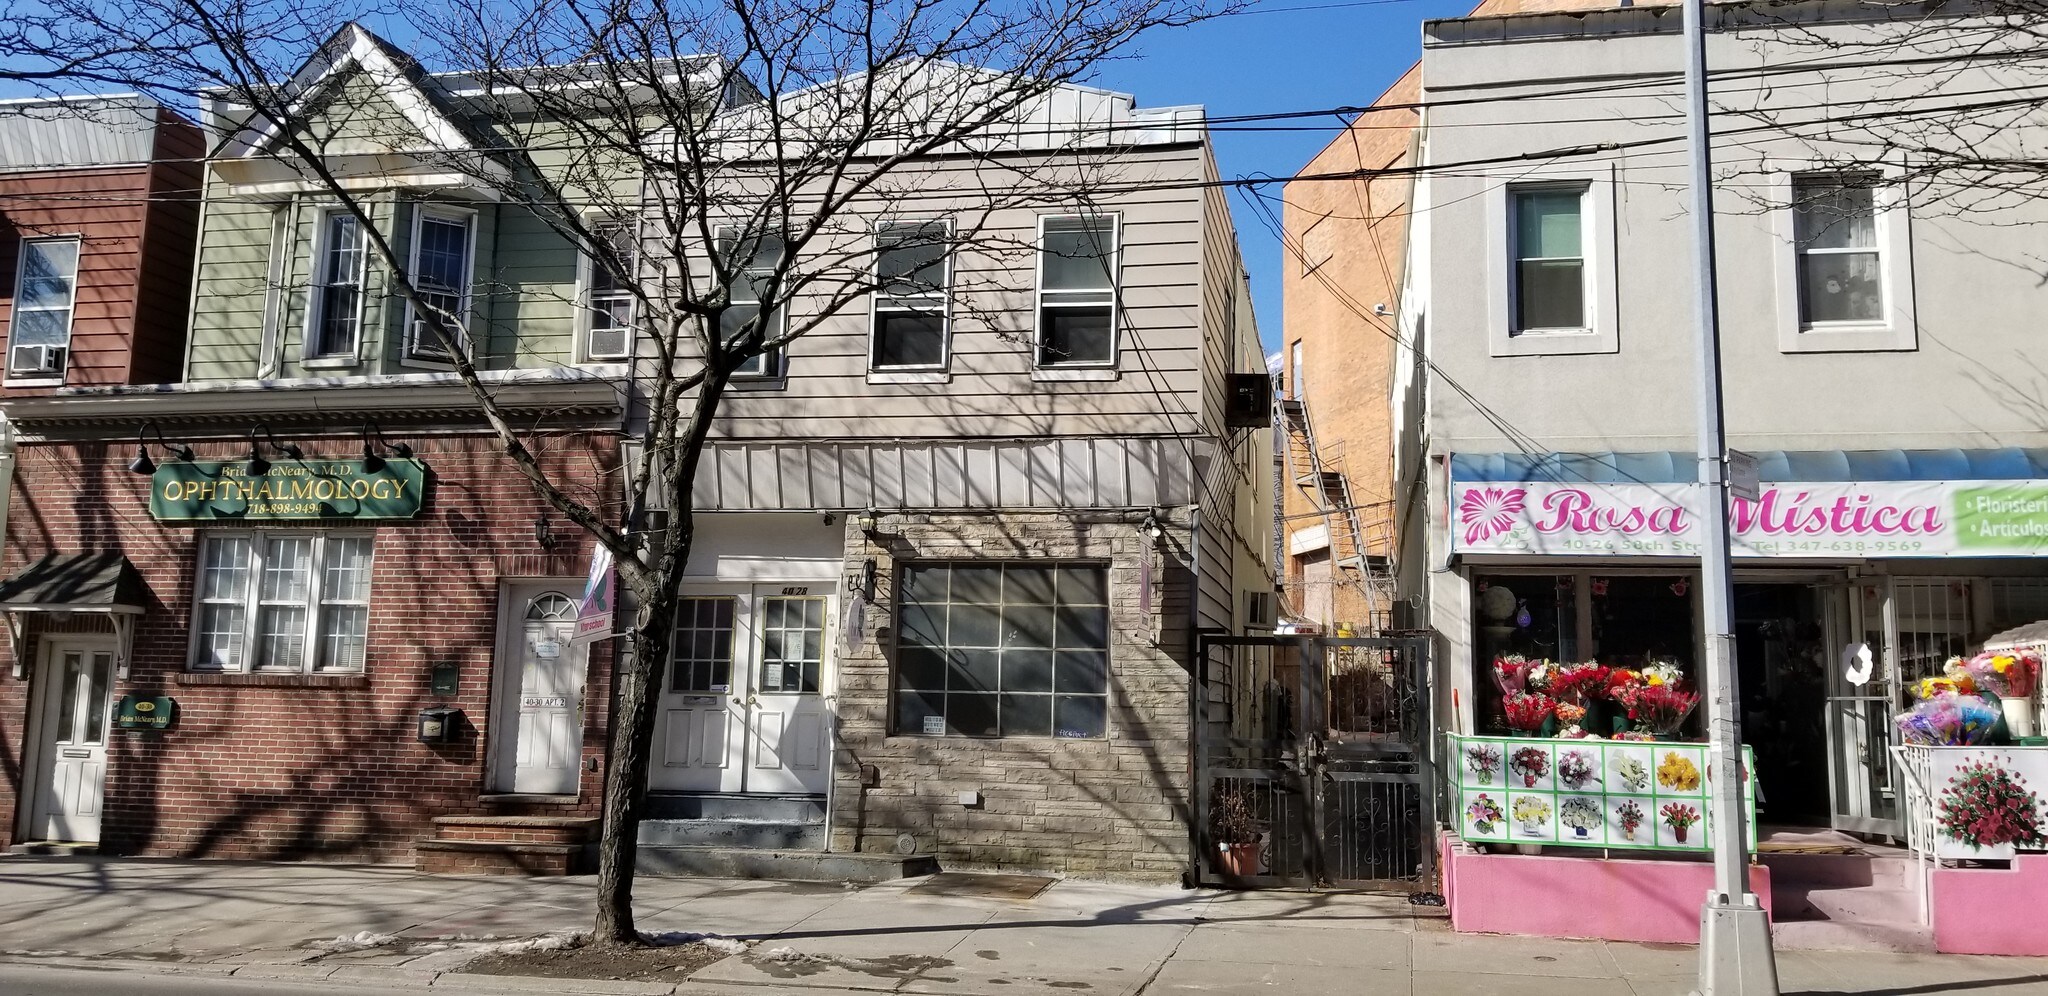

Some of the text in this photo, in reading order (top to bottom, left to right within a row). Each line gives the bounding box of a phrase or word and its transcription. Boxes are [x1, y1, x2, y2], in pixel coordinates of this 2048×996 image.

[221, 465, 246, 477] Bria
[265, 465, 315, 481] cNeary,
[339, 465, 353, 477] D.
[163, 478, 409, 501] OPHTHALMOLOGY
[247, 502, 323, 514] 718-898-9494
[1535, 488, 1944, 534] Rosa Mística
[1980, 519, 2048, 538] Artículos
[1562, 539, 1614, 551] 40-26
[1621, 539, 1664, 551] 58th
[1751, 541, 1779, 552] Tel
[1787, 541, 1922, 552] 347-638-9569
